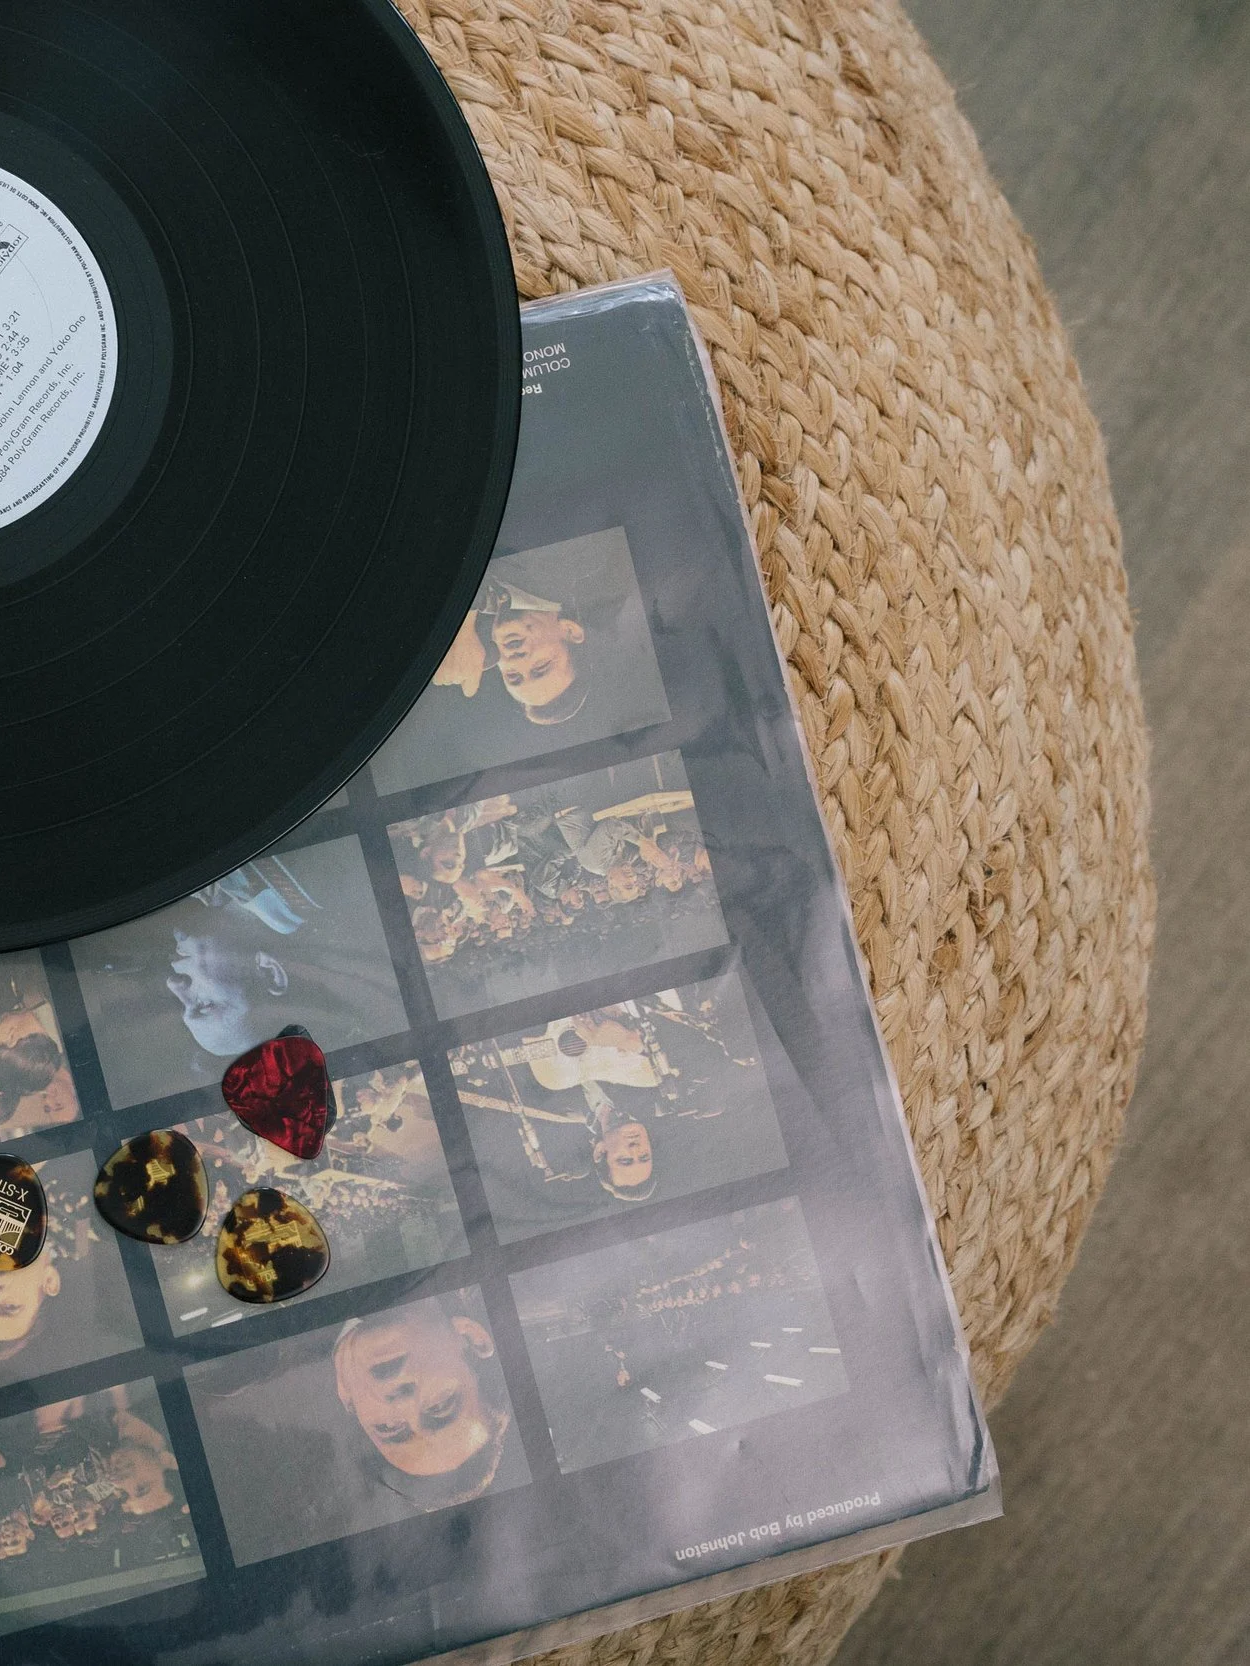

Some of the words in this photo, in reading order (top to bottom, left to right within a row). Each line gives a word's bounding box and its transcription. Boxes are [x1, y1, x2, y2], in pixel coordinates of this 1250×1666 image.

[1, 310, 21, 331] 3:21
[0, 330, 19, 352] 2:44
[10, 334, 30, 357] 3:35
[523, 342, 566, 362] MONO
[5, 360, 24, 381] 1:04
[11, 374, 40, 406] Lennon
[38, 356, 53, 375] and
[48, 334, 71, 356] Yoko
[68, 315, 86, 333] Ono
[27, 380, 61, 415] Records,
[56, 363, 74, 378] Inc.
[7, 423, 43, 465] PolyGram
[39, 389, 73, 423] Records,
[68, 371, 86, 387] Inc.
[806, 1491, 882, 1525] Produced
[748, 1521, 781, 1540] Bob
[785, 1513, 804, 1528] by
[675, 1531, 746, 1560] Johnston
